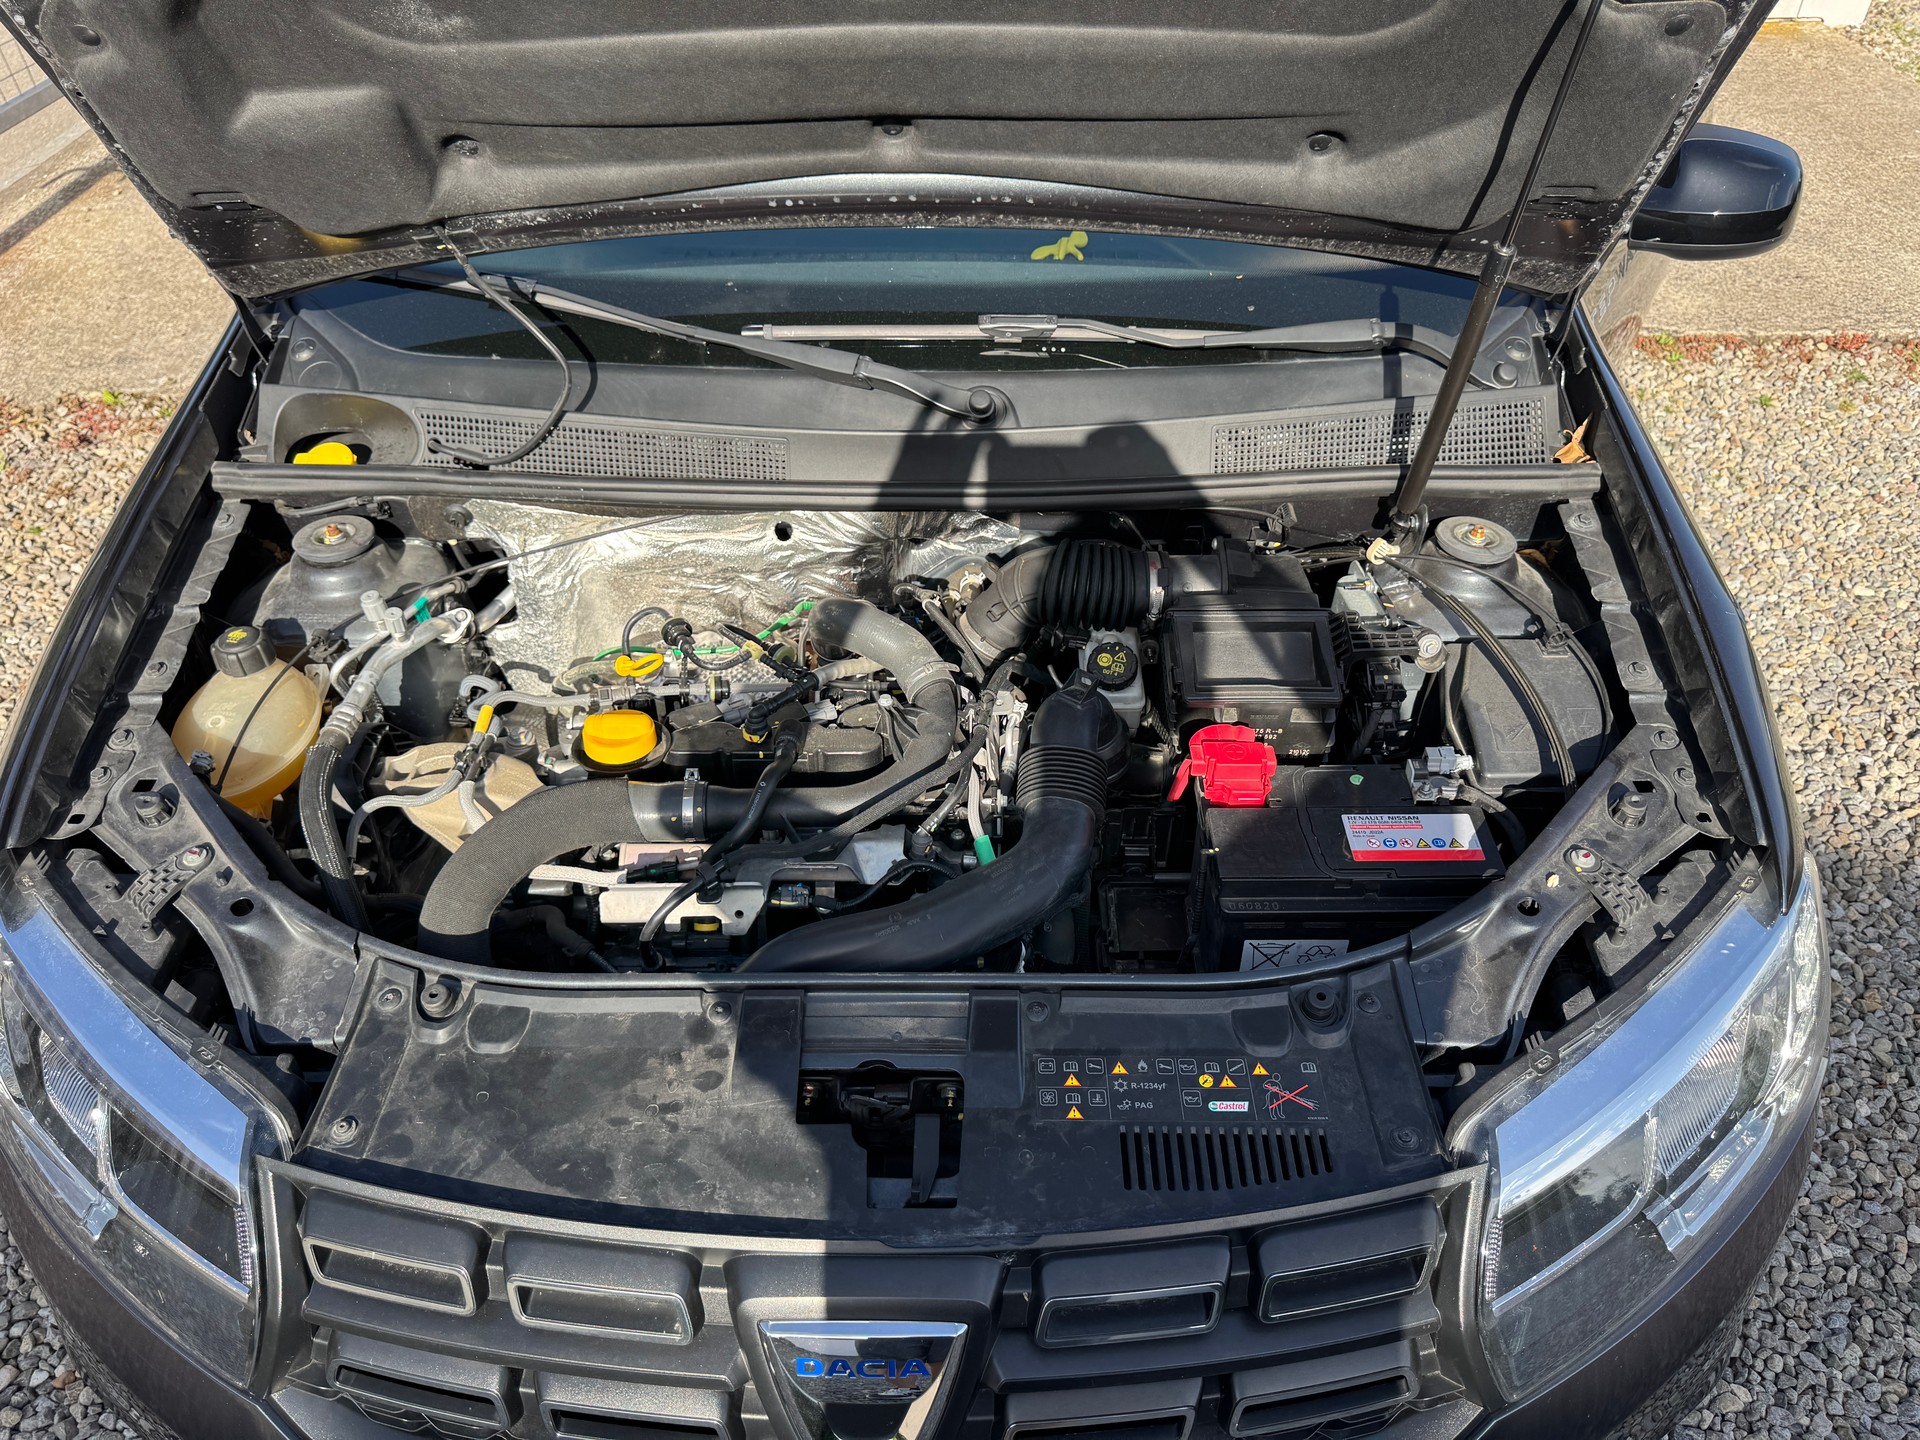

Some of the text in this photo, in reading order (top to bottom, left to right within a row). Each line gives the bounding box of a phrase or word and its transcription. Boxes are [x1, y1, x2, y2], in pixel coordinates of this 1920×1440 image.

[1131, 1082, 1166, 1091] R-1234yf
[1134, 1101, 1154, 1109] PAG
[1218, 1102, 1246, 1110] Castrol
[795, 1356, 931, 1379] DACIA
